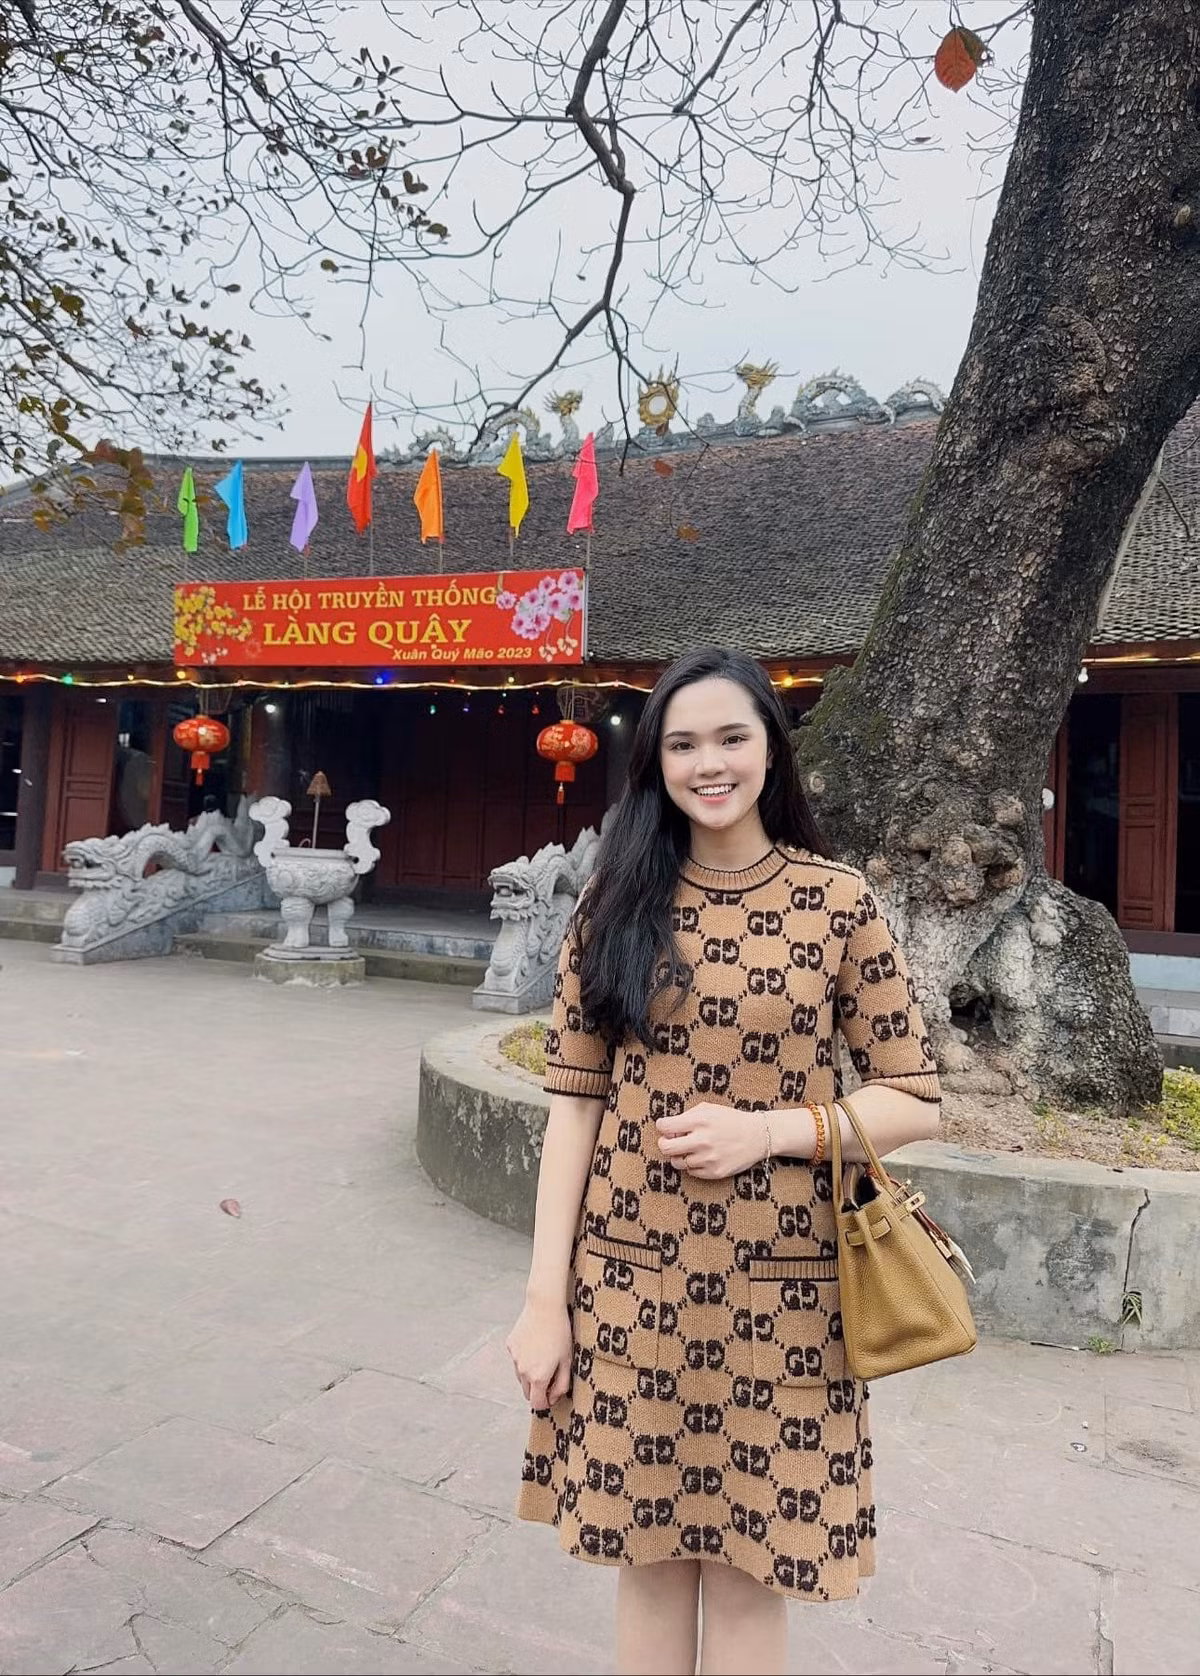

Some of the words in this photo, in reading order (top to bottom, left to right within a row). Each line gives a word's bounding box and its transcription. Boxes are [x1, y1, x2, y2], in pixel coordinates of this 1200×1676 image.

[243, 586, 266, 610] LỄ
[272, 588, 312, 614] HỘI
[317, 580, 405, 610] TRUYỀN
[411, 579, 497, 607] THỐNG
[263, 615, 357, 645] LÀNG
[368, 613, 472, 650] QUẬY
[392, 649, 427, 661] Xuân
[431, 647, 461, 662] Quý
[463, 647, 494, 660] Mão
[497, 646, 533, 660] 2023
